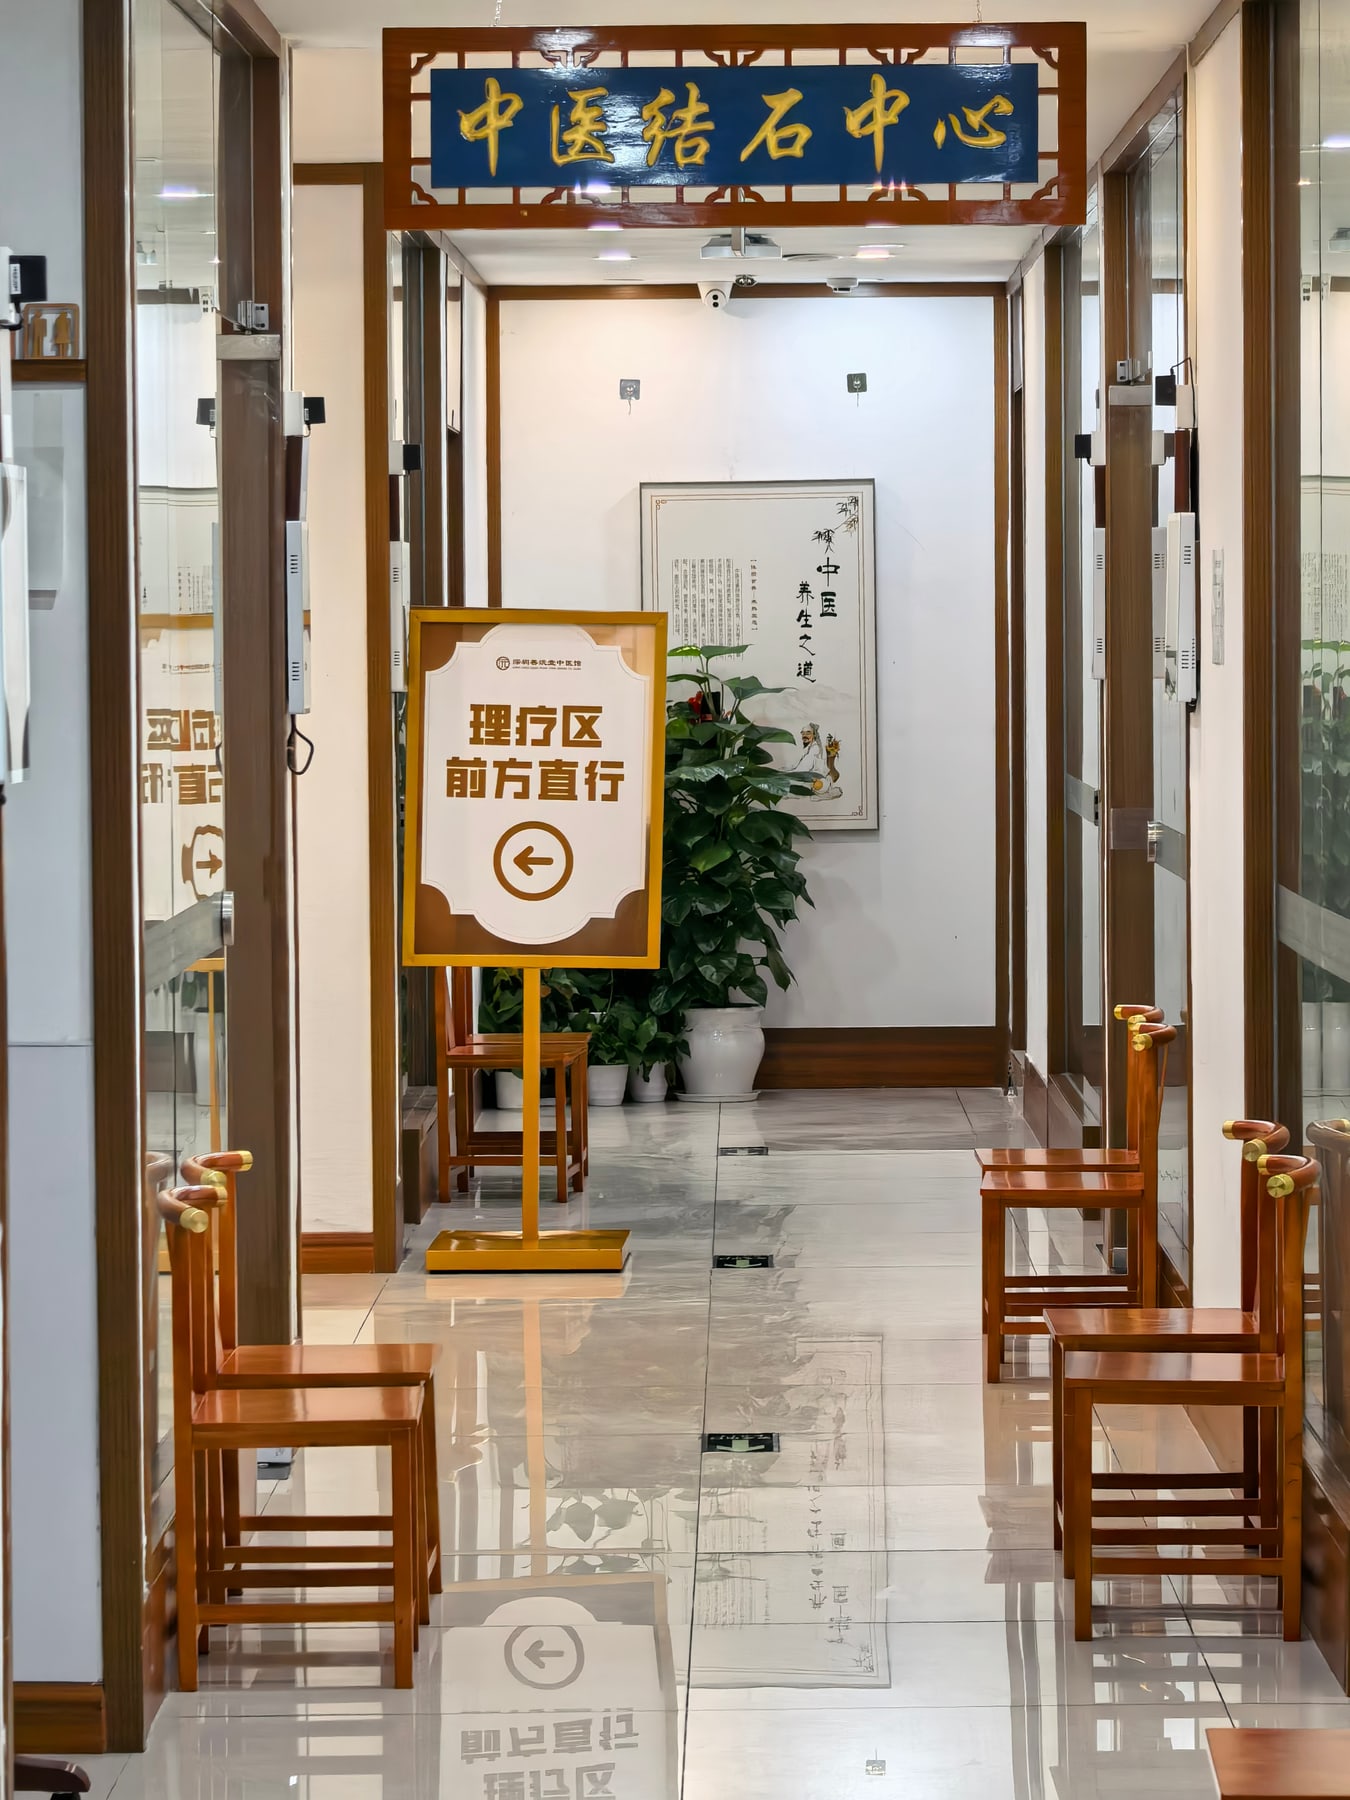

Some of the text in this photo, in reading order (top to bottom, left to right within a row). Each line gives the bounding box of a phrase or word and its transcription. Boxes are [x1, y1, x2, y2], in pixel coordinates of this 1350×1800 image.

[456, 73, 1014, 177] 中医结石中心
[816, 556, 841, 618] 中医
[796, 581, 817, 683] 养生之道
[469, 703, 603, 748] 理疗区
[446, 756, 625, 802] 前方直行
